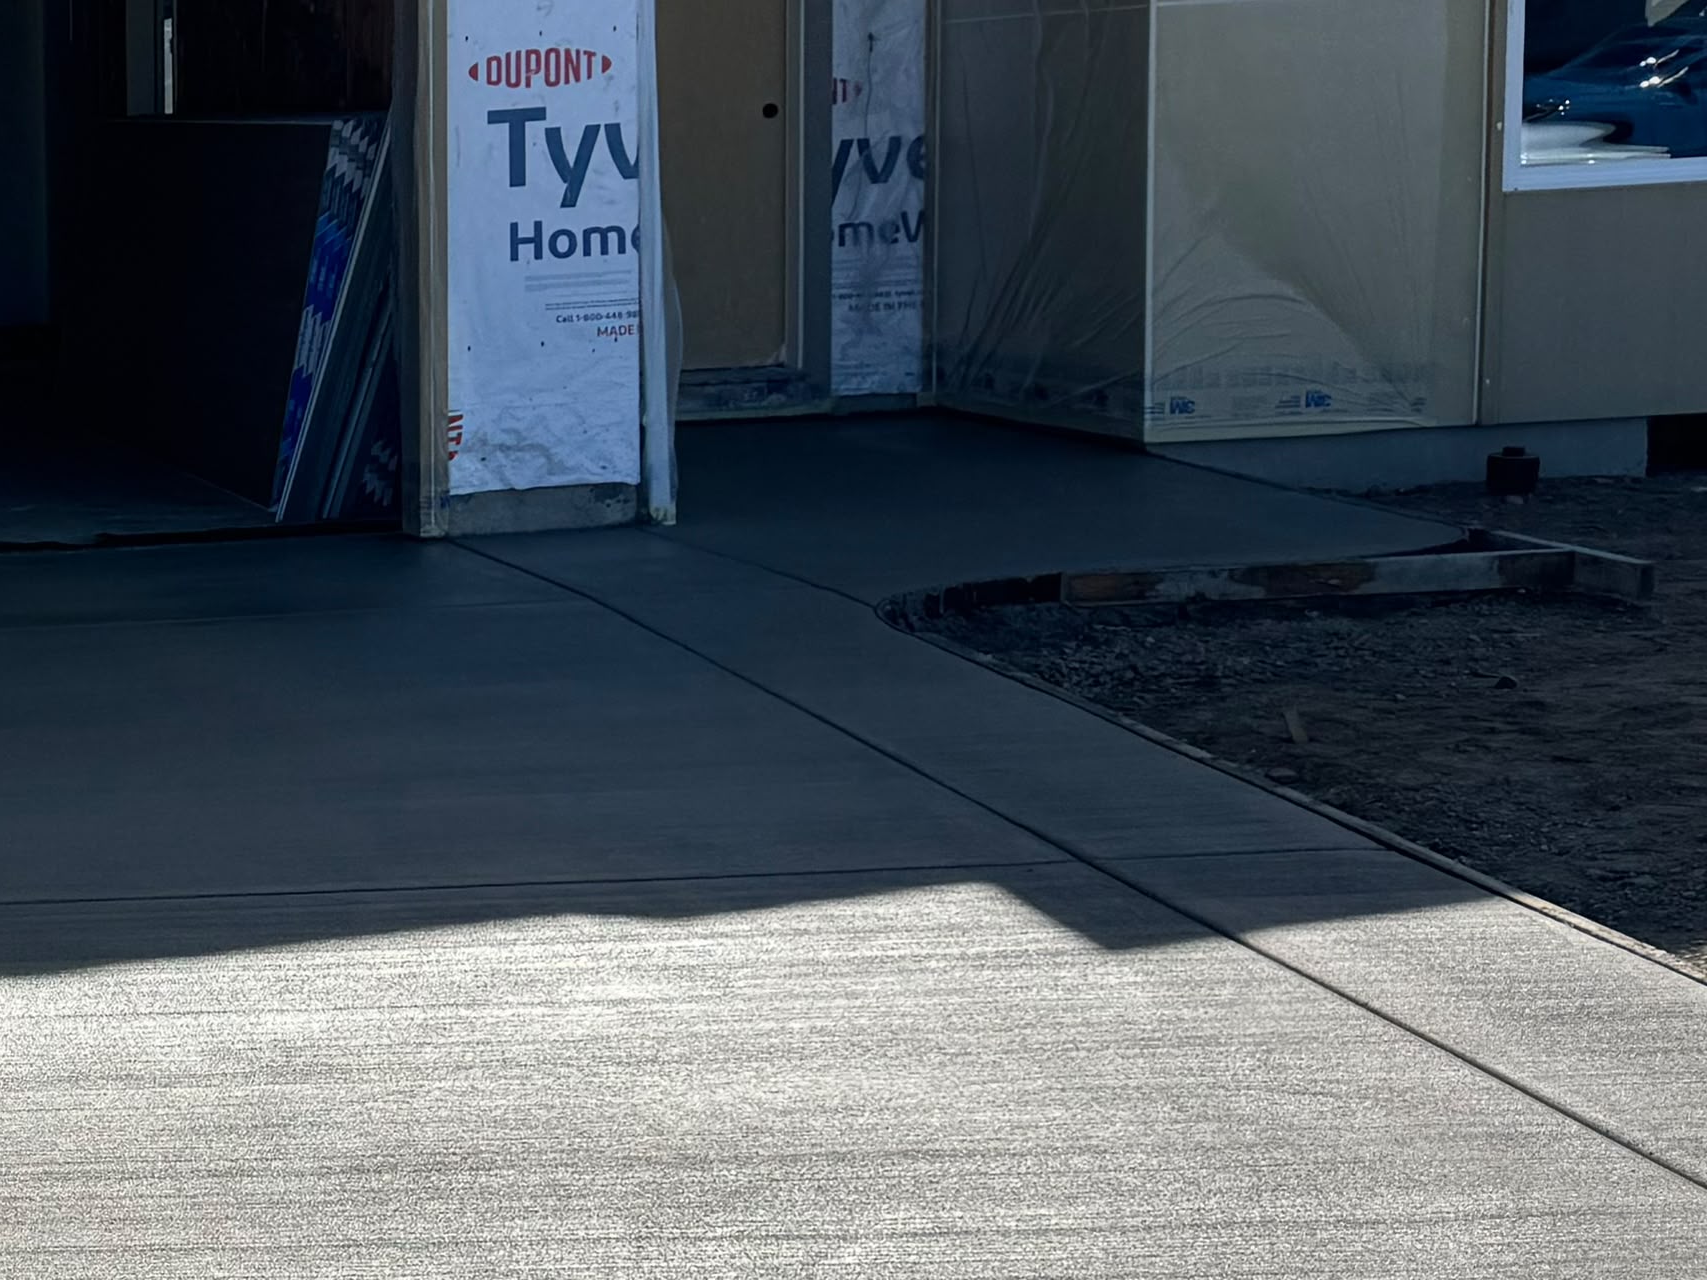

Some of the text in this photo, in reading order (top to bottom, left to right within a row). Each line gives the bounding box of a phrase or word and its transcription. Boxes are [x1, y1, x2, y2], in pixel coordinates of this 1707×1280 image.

[485, 47, 597, 89] DUPONT
[487, 106, 640, 208] Tyv
[597, 324, 635, 337] MADE
